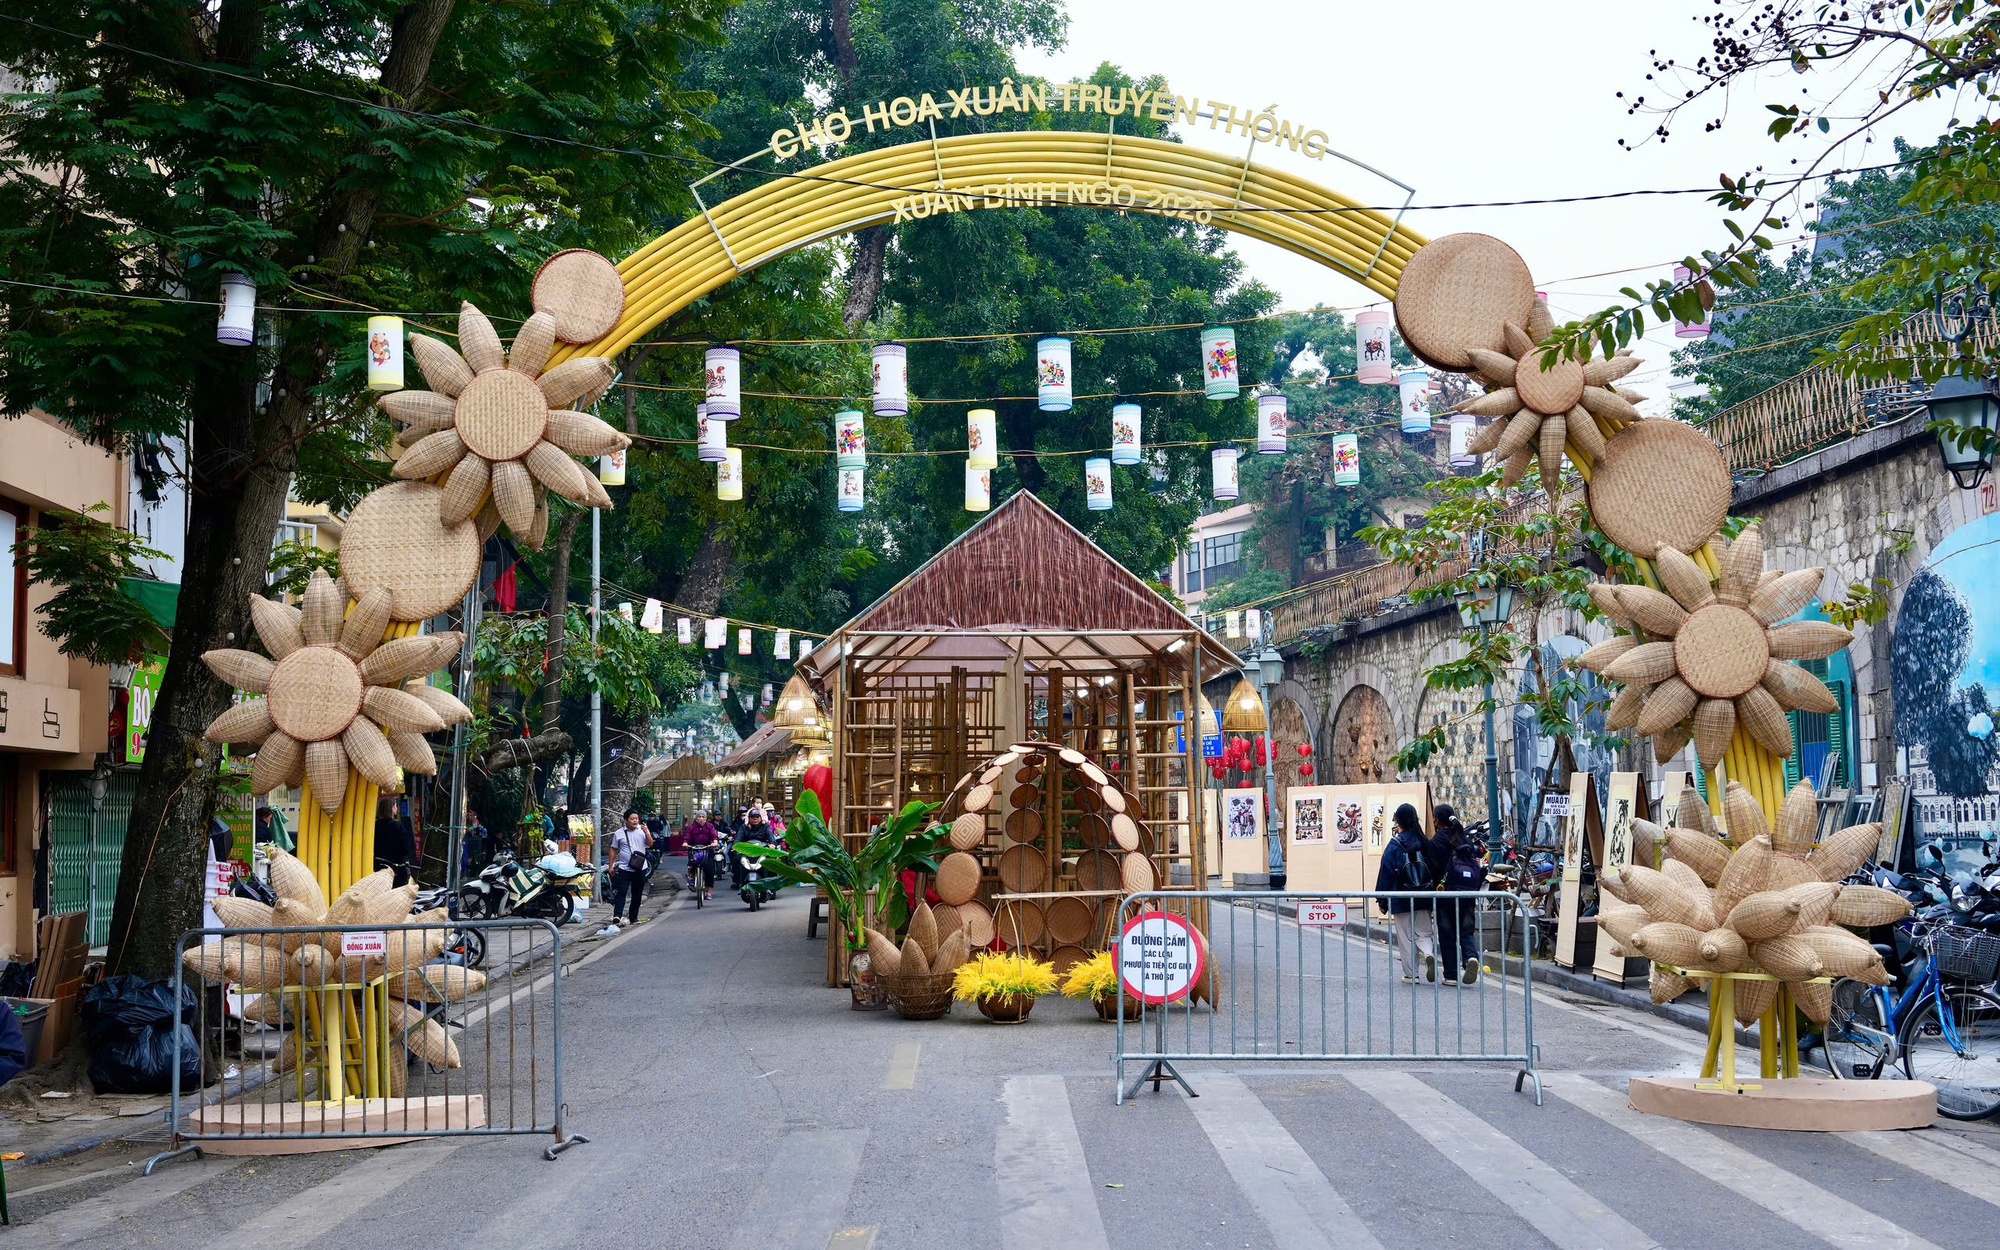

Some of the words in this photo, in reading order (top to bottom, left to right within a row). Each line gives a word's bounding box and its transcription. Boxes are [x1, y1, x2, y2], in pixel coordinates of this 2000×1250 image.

[771, 106, 852, 158] CHỢ
[863, 93, 944, 133] HOA
[947, 77, 1046, 118] XUÂN
[1056, 80, 1199, 126] TRUYỀN
[1207, 103, 1330, 161] THỐNG
[888, 183, 974, 225] XUÂN
[983, 176, 1057, 209] BÍNH
[1068, 181, 1136, 216] NGỌ
[1144, 188, 1213, 225] 2026
[1983, 484, 1994, 508] 72
[132, 674, 151, 729] BÒ
[1166, 934, 1186, 947] CẤM
[1143, 949, 1157, 957] CÁC
[1168, 962, 1177, 970] CƠ
